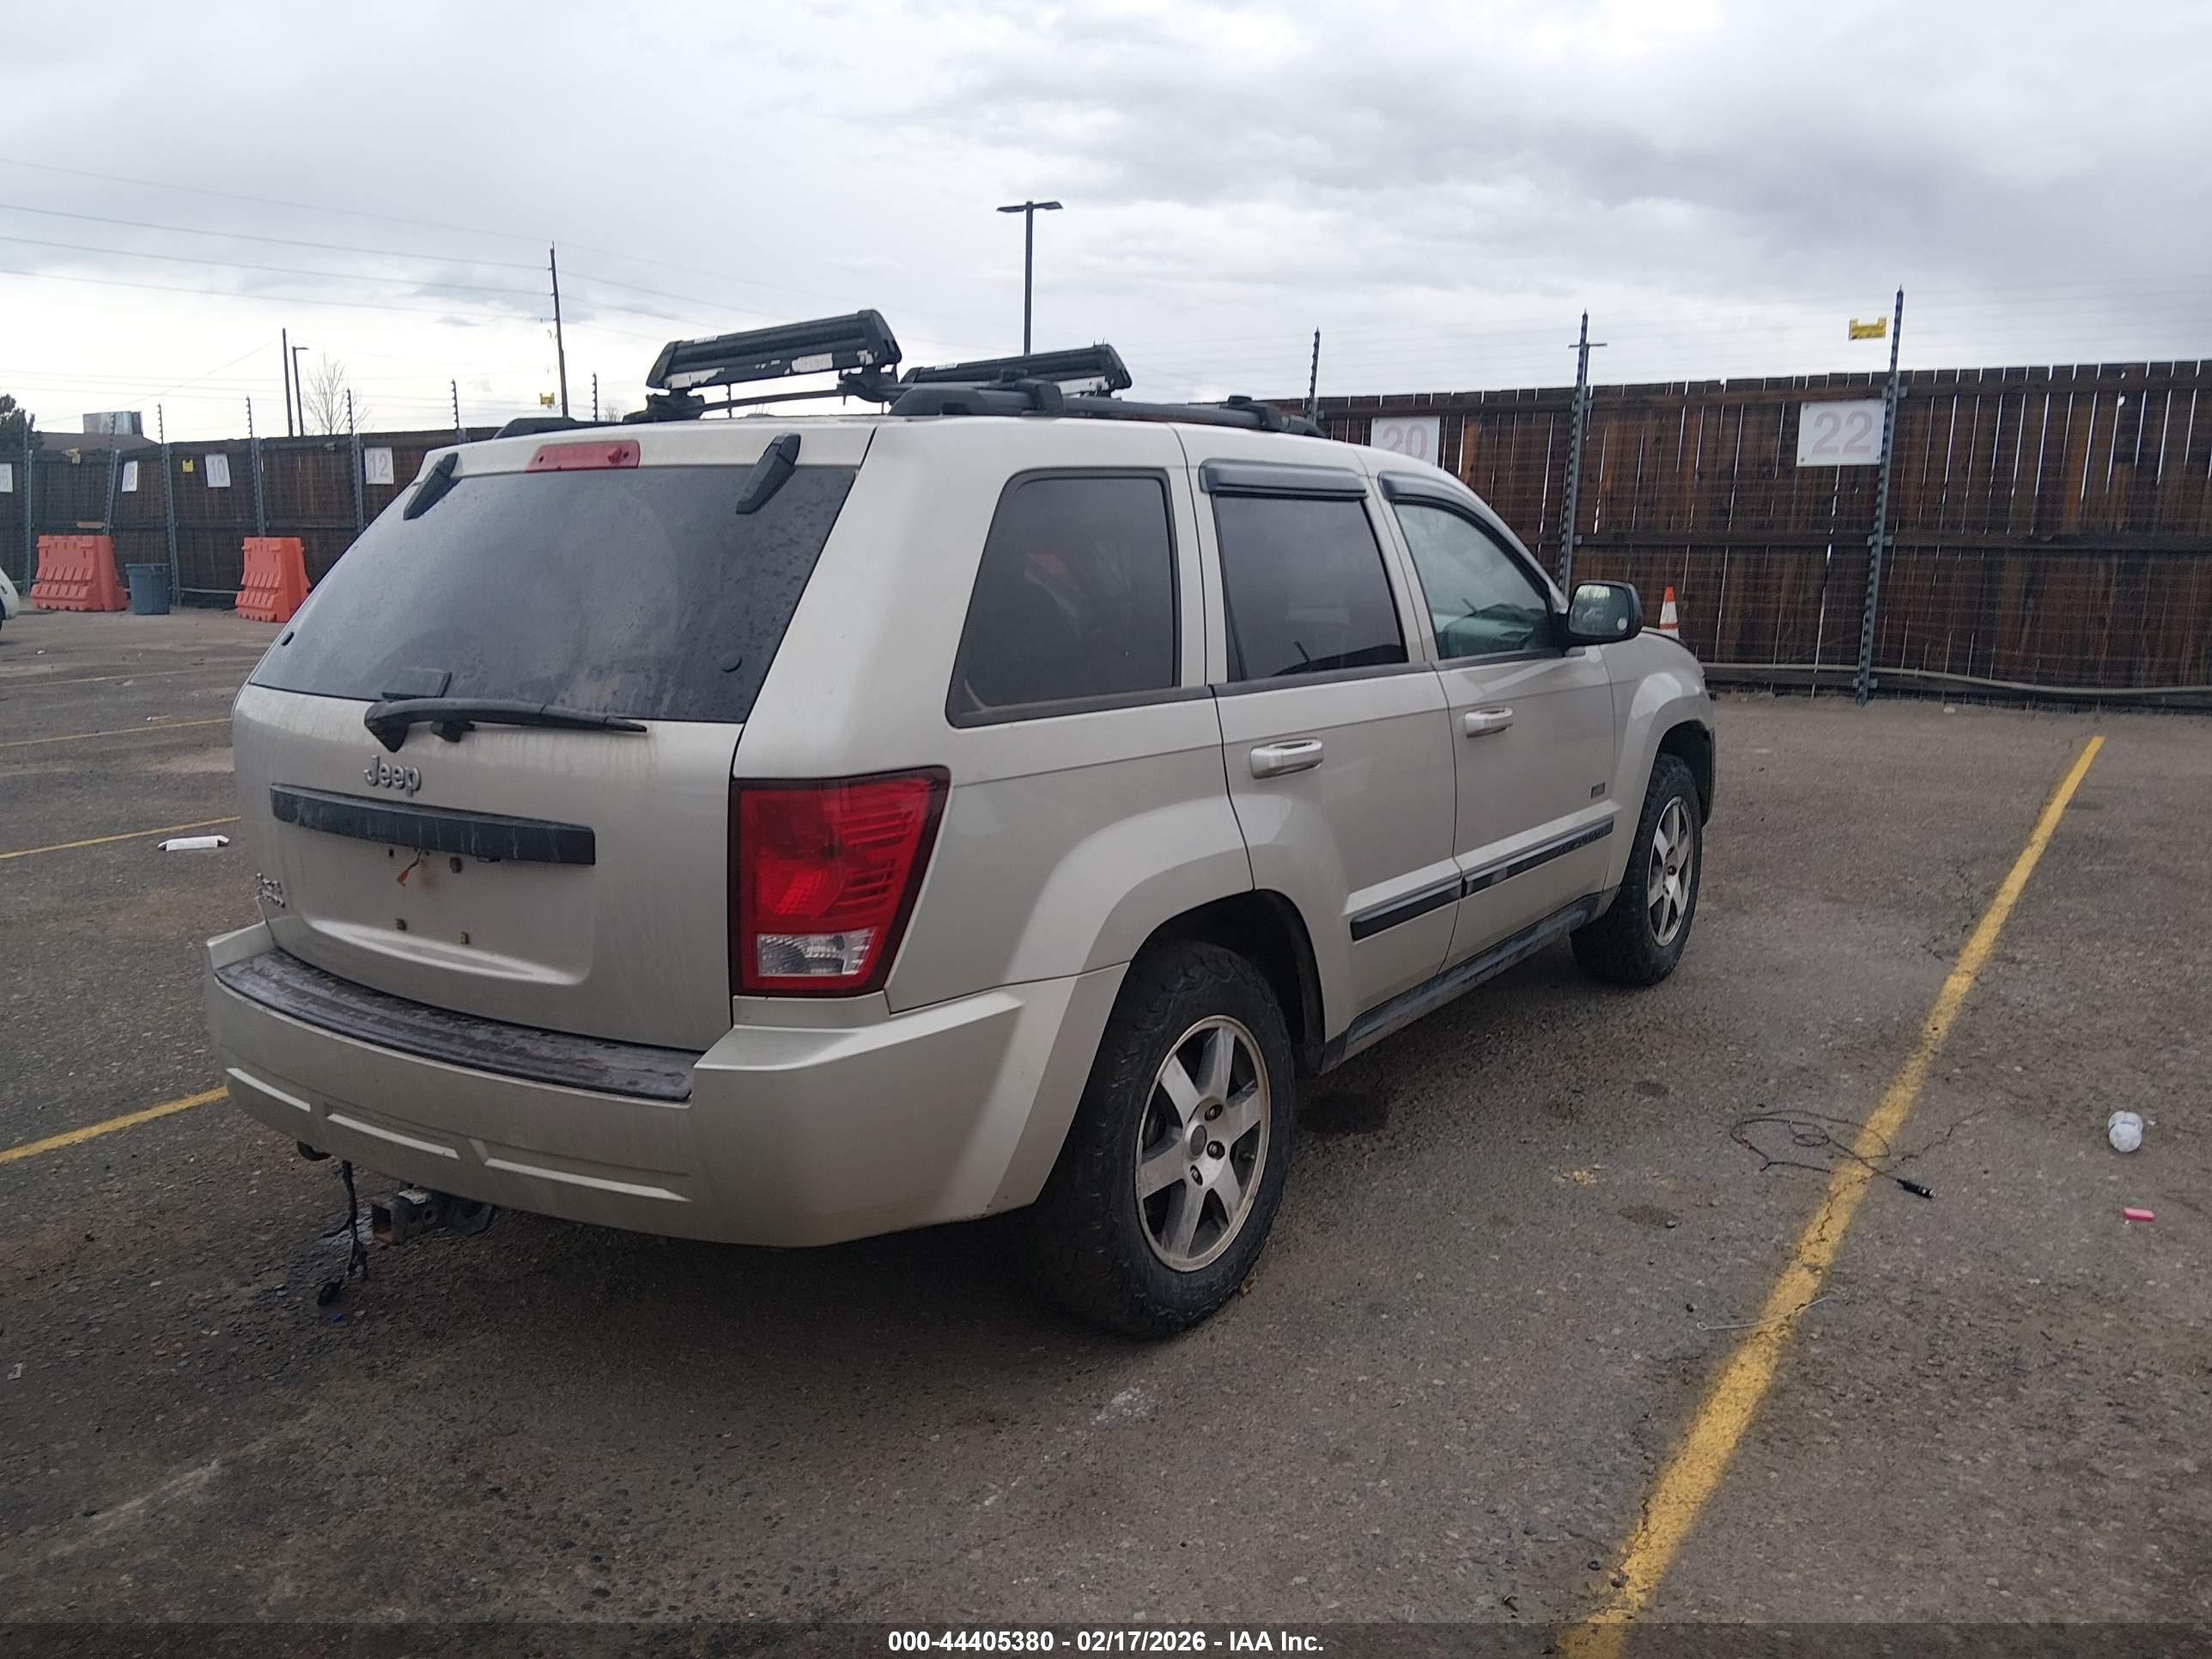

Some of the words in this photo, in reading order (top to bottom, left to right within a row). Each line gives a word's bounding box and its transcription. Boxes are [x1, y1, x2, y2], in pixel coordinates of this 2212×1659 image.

[1382, 423, 1428, 460] 20
[1812, 410, 1873, 453] 22
[211, 457, 226, 481] 10
[369, 453, 389, 478] 12
[363, 754, 422, 797] Jeep
